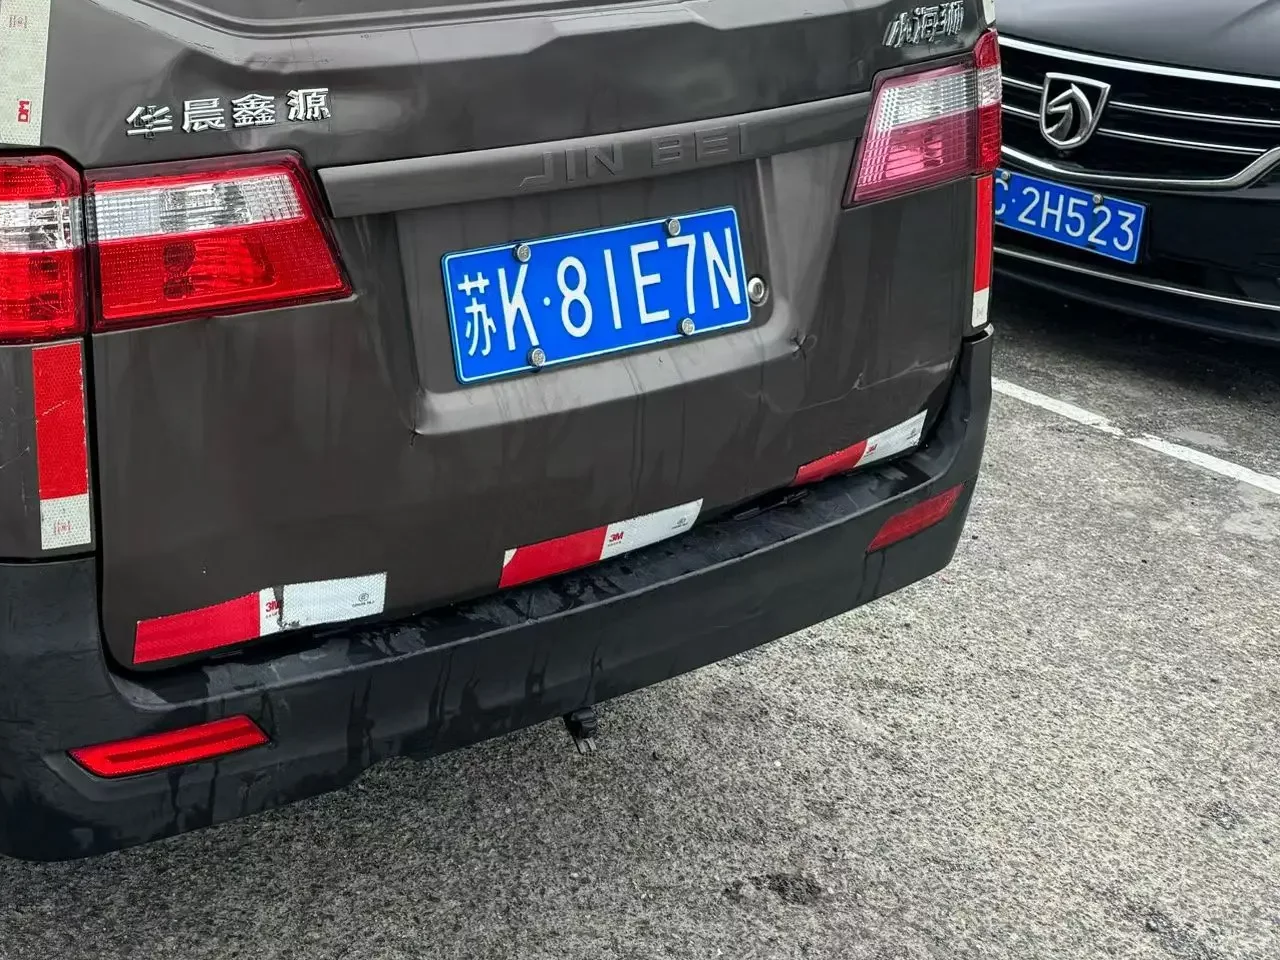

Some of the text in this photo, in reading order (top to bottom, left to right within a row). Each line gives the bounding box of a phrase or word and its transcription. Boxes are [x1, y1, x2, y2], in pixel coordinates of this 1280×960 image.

[18, 100, 30, 123] DM
[126, 87, 331, 139] 华晨鑫源
[458, 226, 741, 357] 苏K·81E7N
[609, 531, 624, 543] 3M
